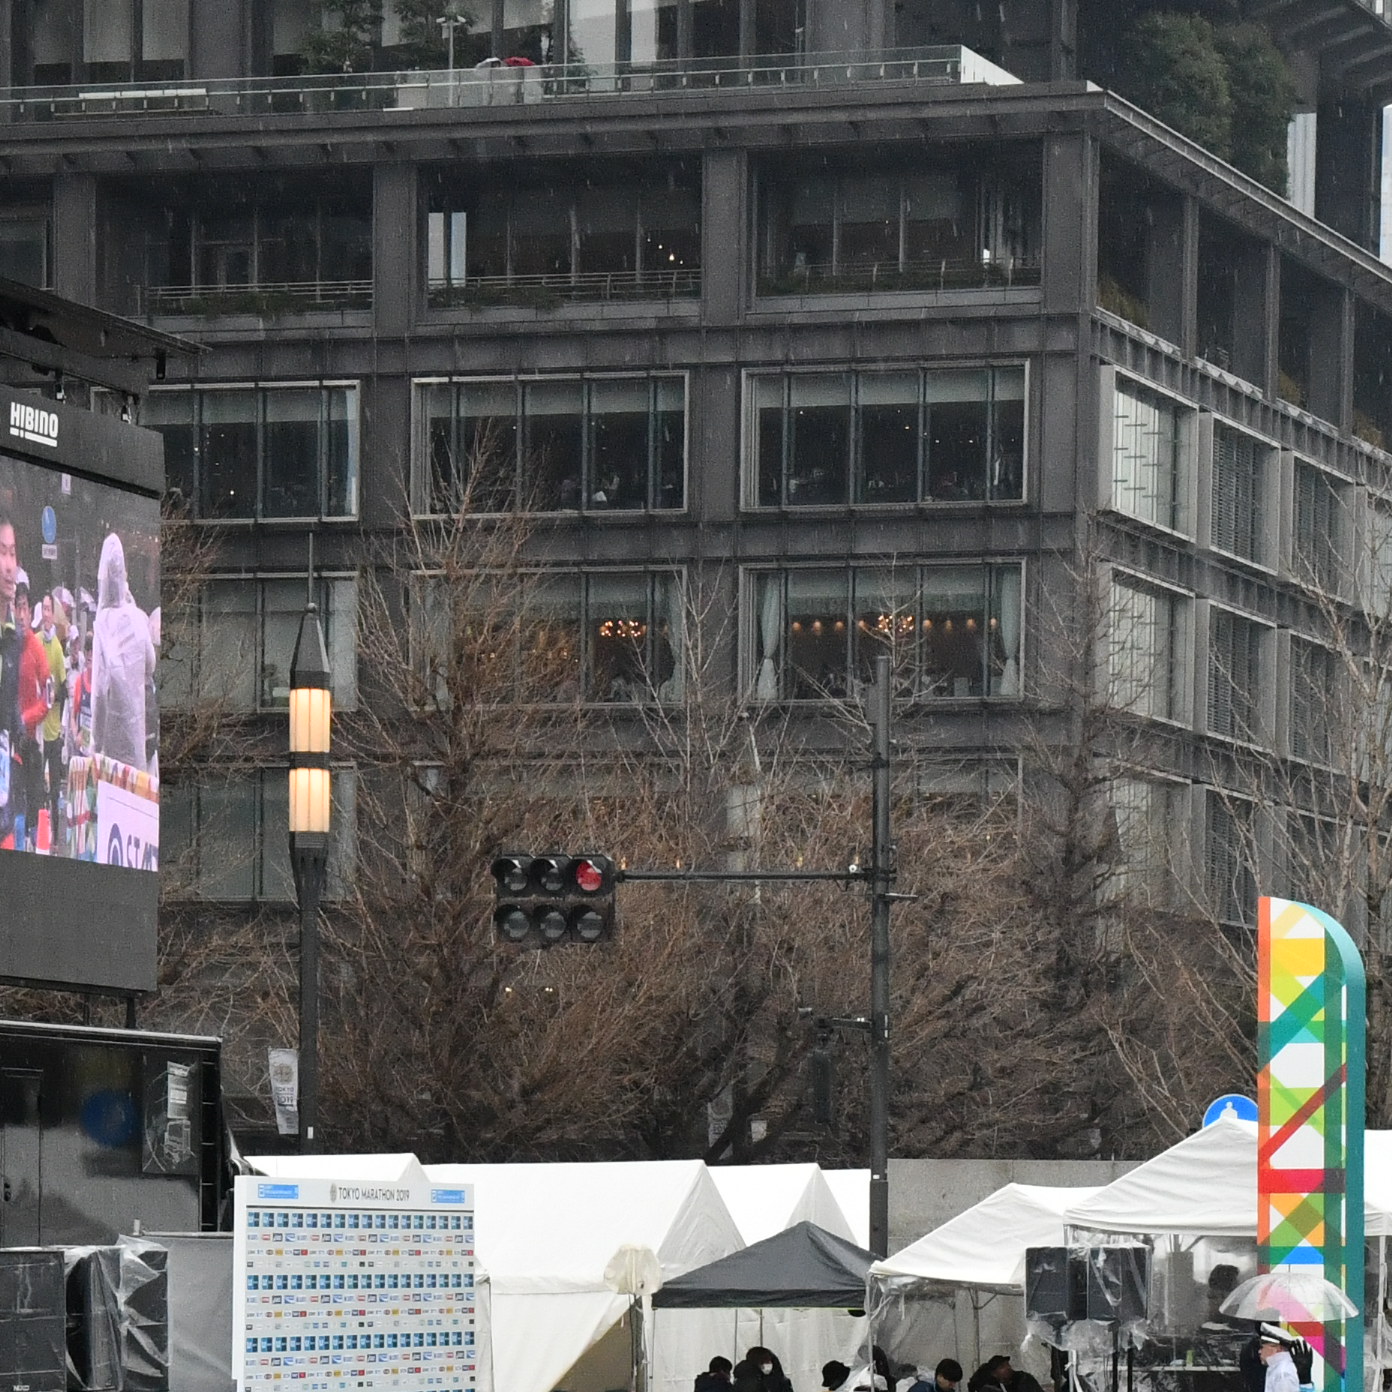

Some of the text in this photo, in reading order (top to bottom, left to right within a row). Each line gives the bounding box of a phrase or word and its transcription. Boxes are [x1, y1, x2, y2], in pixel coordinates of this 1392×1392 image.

[10, 401, 58, 438] HIBINO
[338, 1187, 410, 1201] TOKYO MARATHON 2019
